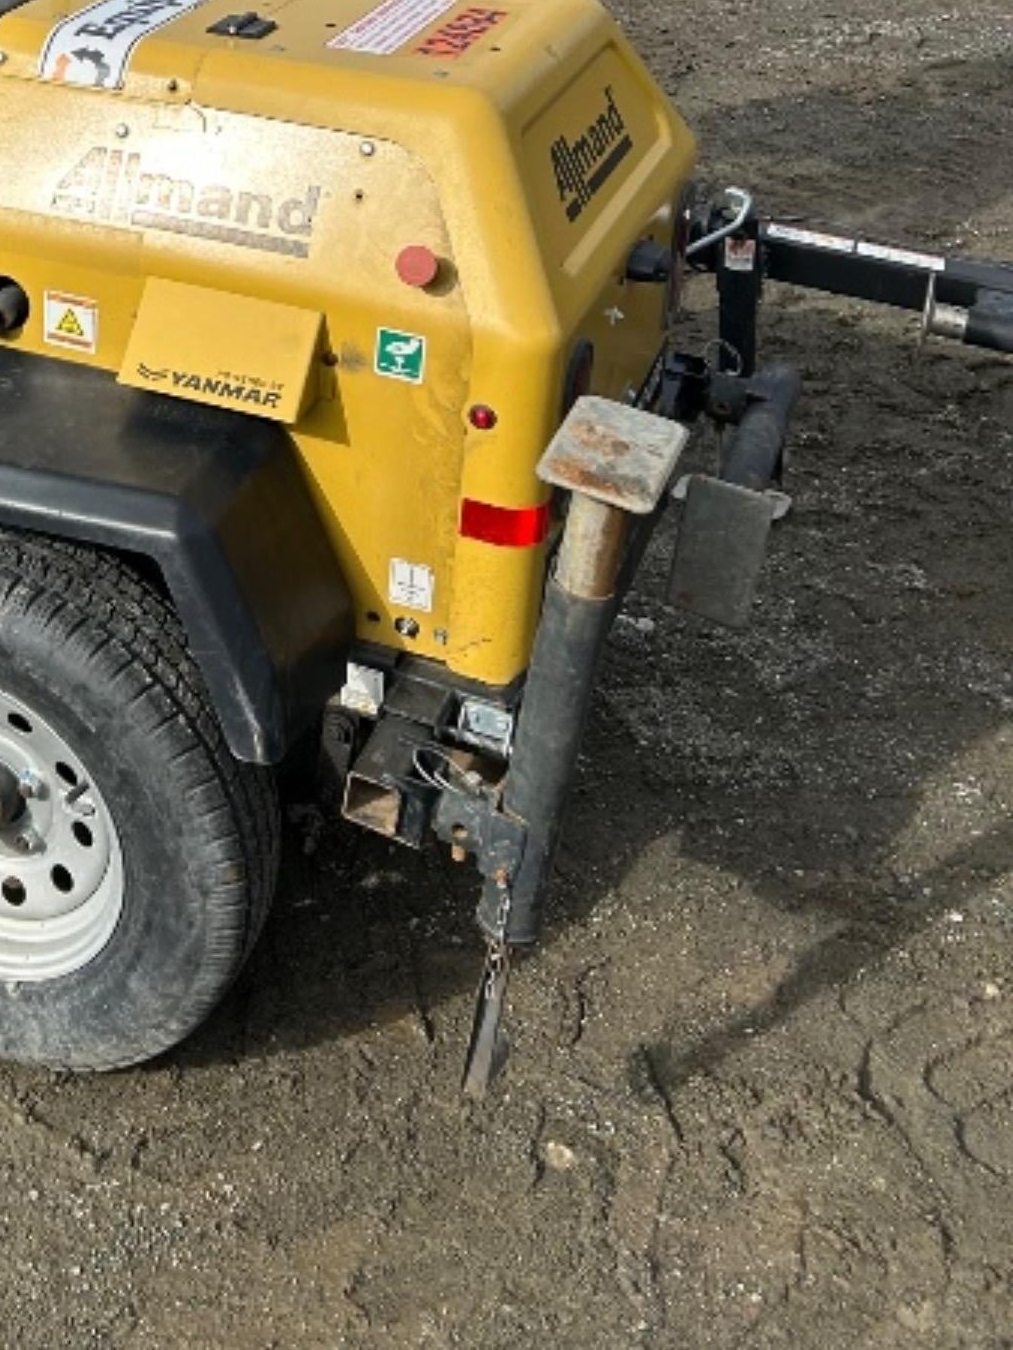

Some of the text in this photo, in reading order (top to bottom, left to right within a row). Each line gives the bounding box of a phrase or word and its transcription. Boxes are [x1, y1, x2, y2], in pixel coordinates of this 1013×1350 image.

[50, 146, 322, 238] Allmand
[550, 84, 626, 208] Allmand
[171, 371, 283, 409] YANMAR
